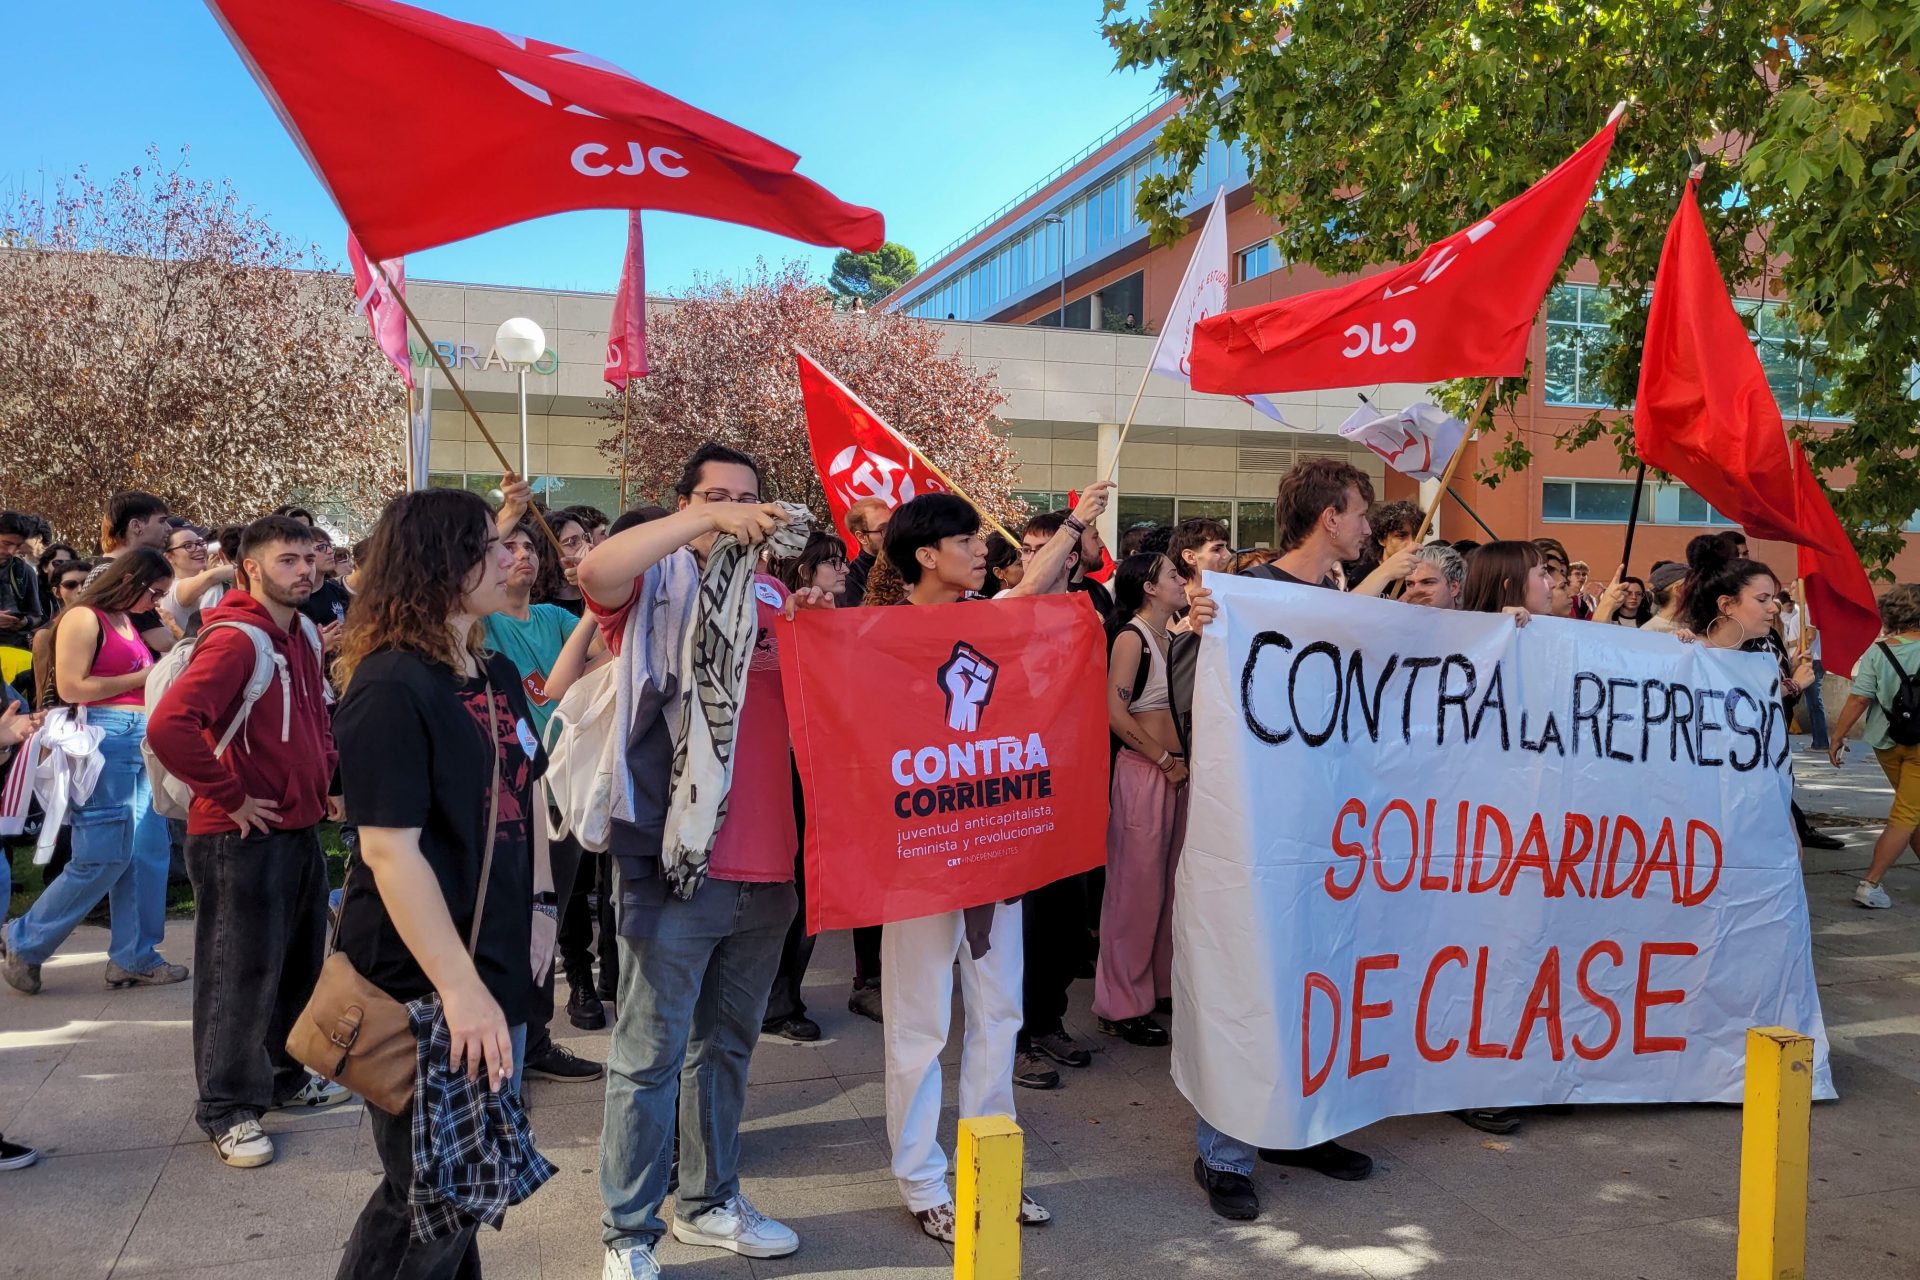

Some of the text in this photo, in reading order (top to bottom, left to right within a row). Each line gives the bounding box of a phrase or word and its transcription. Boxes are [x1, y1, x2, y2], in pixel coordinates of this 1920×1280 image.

[570, 141, 690, 178] CJC
[533, 687, 548, 697] CJ
[1240, 630, 1794, 775] CONTRA LA REPRESIÓ
[891, 732, 1049, 787] CONTRA
[894, 769, 1055, 819] CORRIENTE
[897, 805, 1054, 845] juventud anticapitalista,
[897, 821, 1055, 860] feminista y revolucionaria
[1324, 797, 1723, 908] SOLIDARIDAD
[1301, 940, 1699, 1098] DE CLASE
